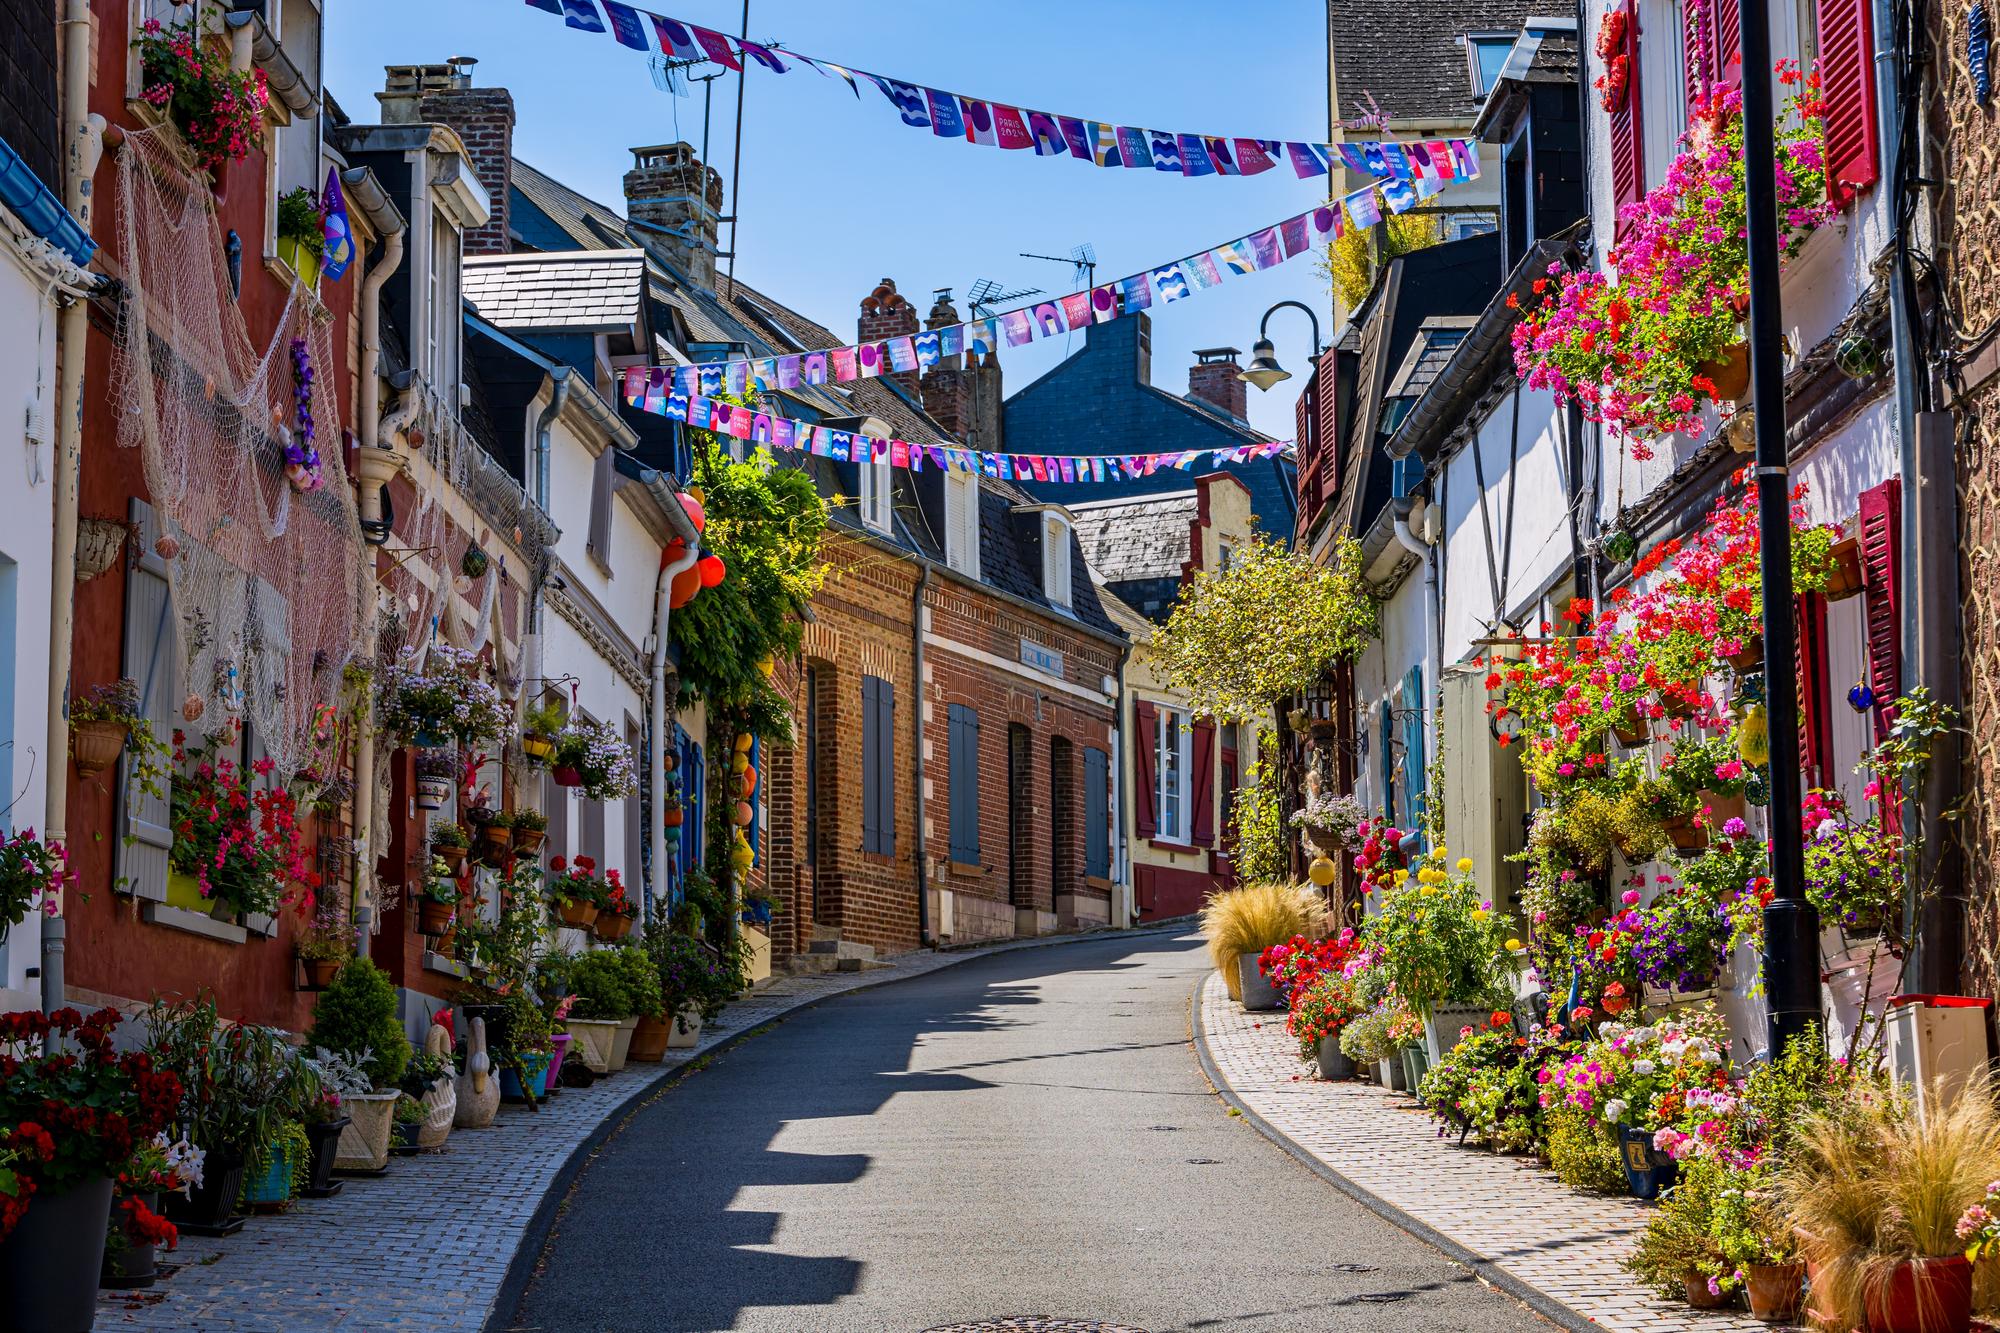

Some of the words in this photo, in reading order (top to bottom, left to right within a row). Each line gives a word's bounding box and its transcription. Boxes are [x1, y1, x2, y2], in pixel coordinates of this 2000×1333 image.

[999, 118, 1021, 129] PARIS
[1000, 127, 1025, 137] 2024
[1121, 137, 1144, 147] PARIS
[1125, 146, 1146, 156] 2024
[1193, 159, 1205, 167] JEUX
